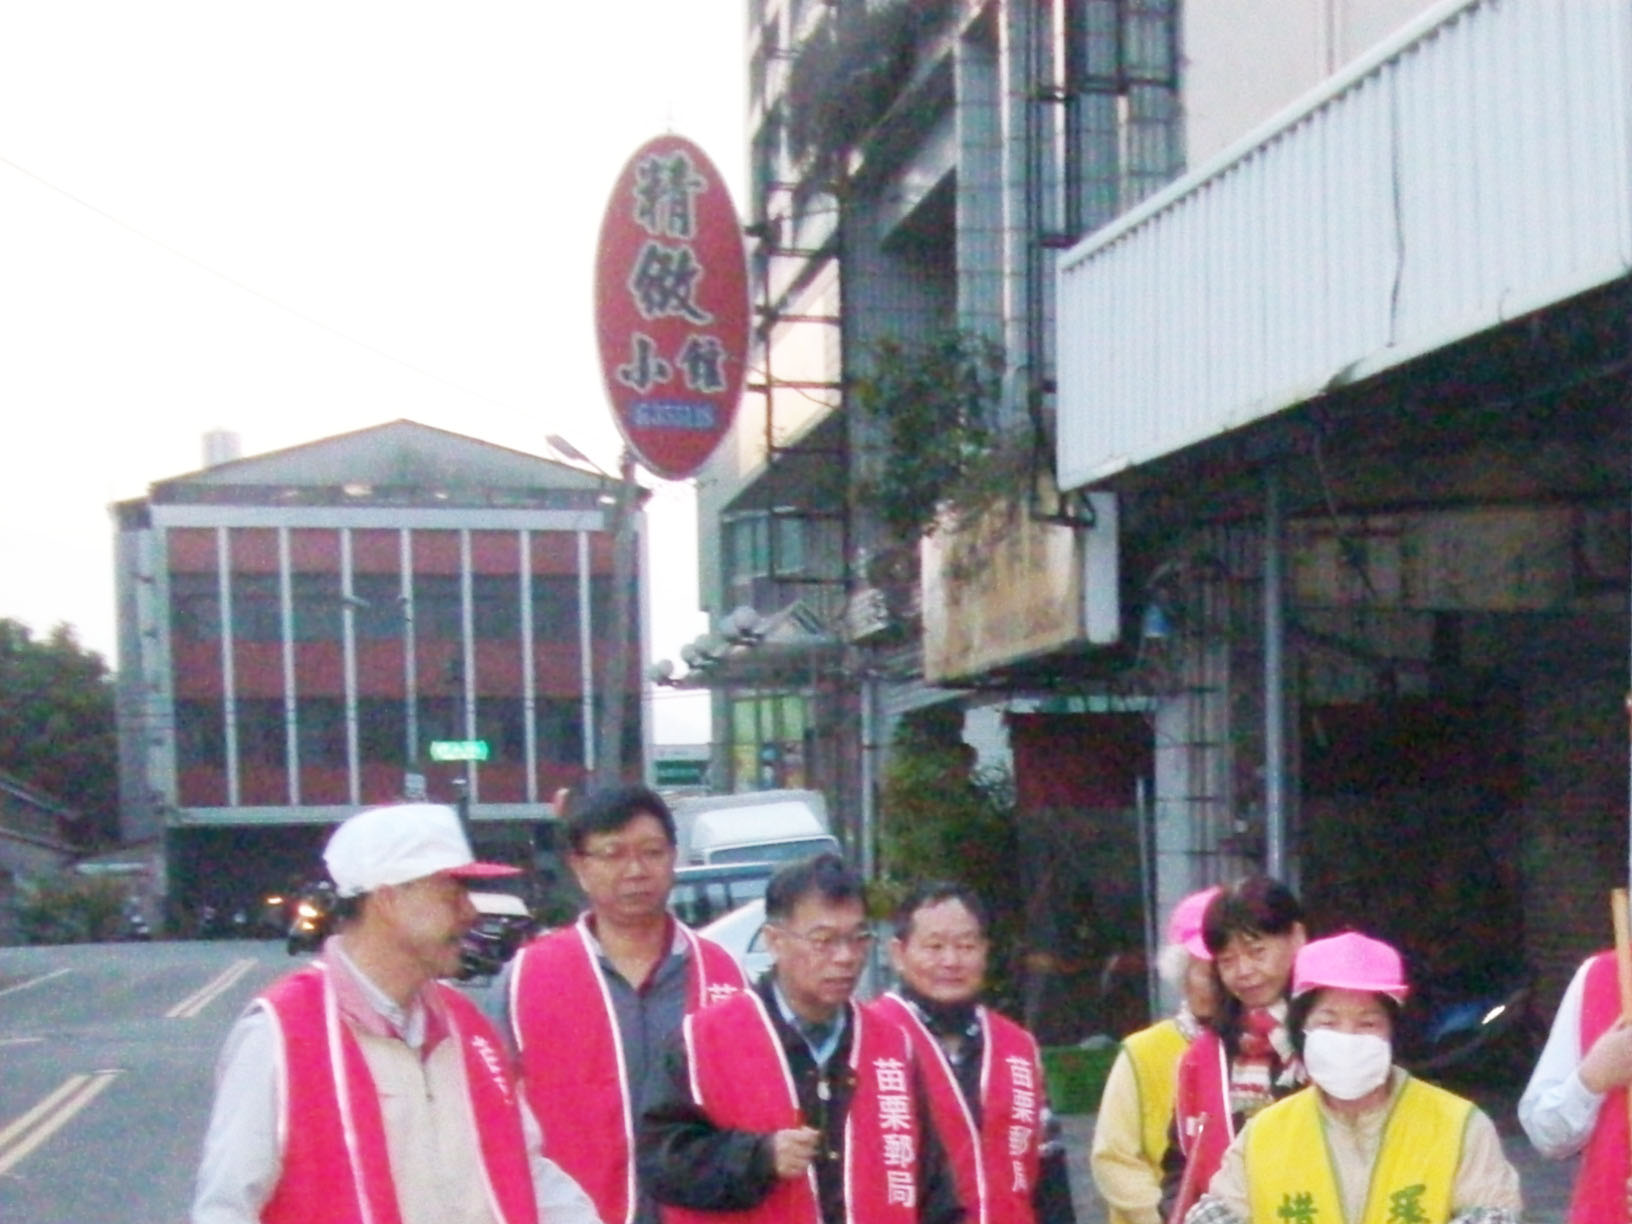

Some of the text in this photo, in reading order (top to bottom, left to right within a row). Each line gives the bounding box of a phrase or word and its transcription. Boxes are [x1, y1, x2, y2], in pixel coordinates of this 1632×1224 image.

[628, 148, 714, 326] 精做
[872, 1057, 916, 1208] 苗栗郵局
